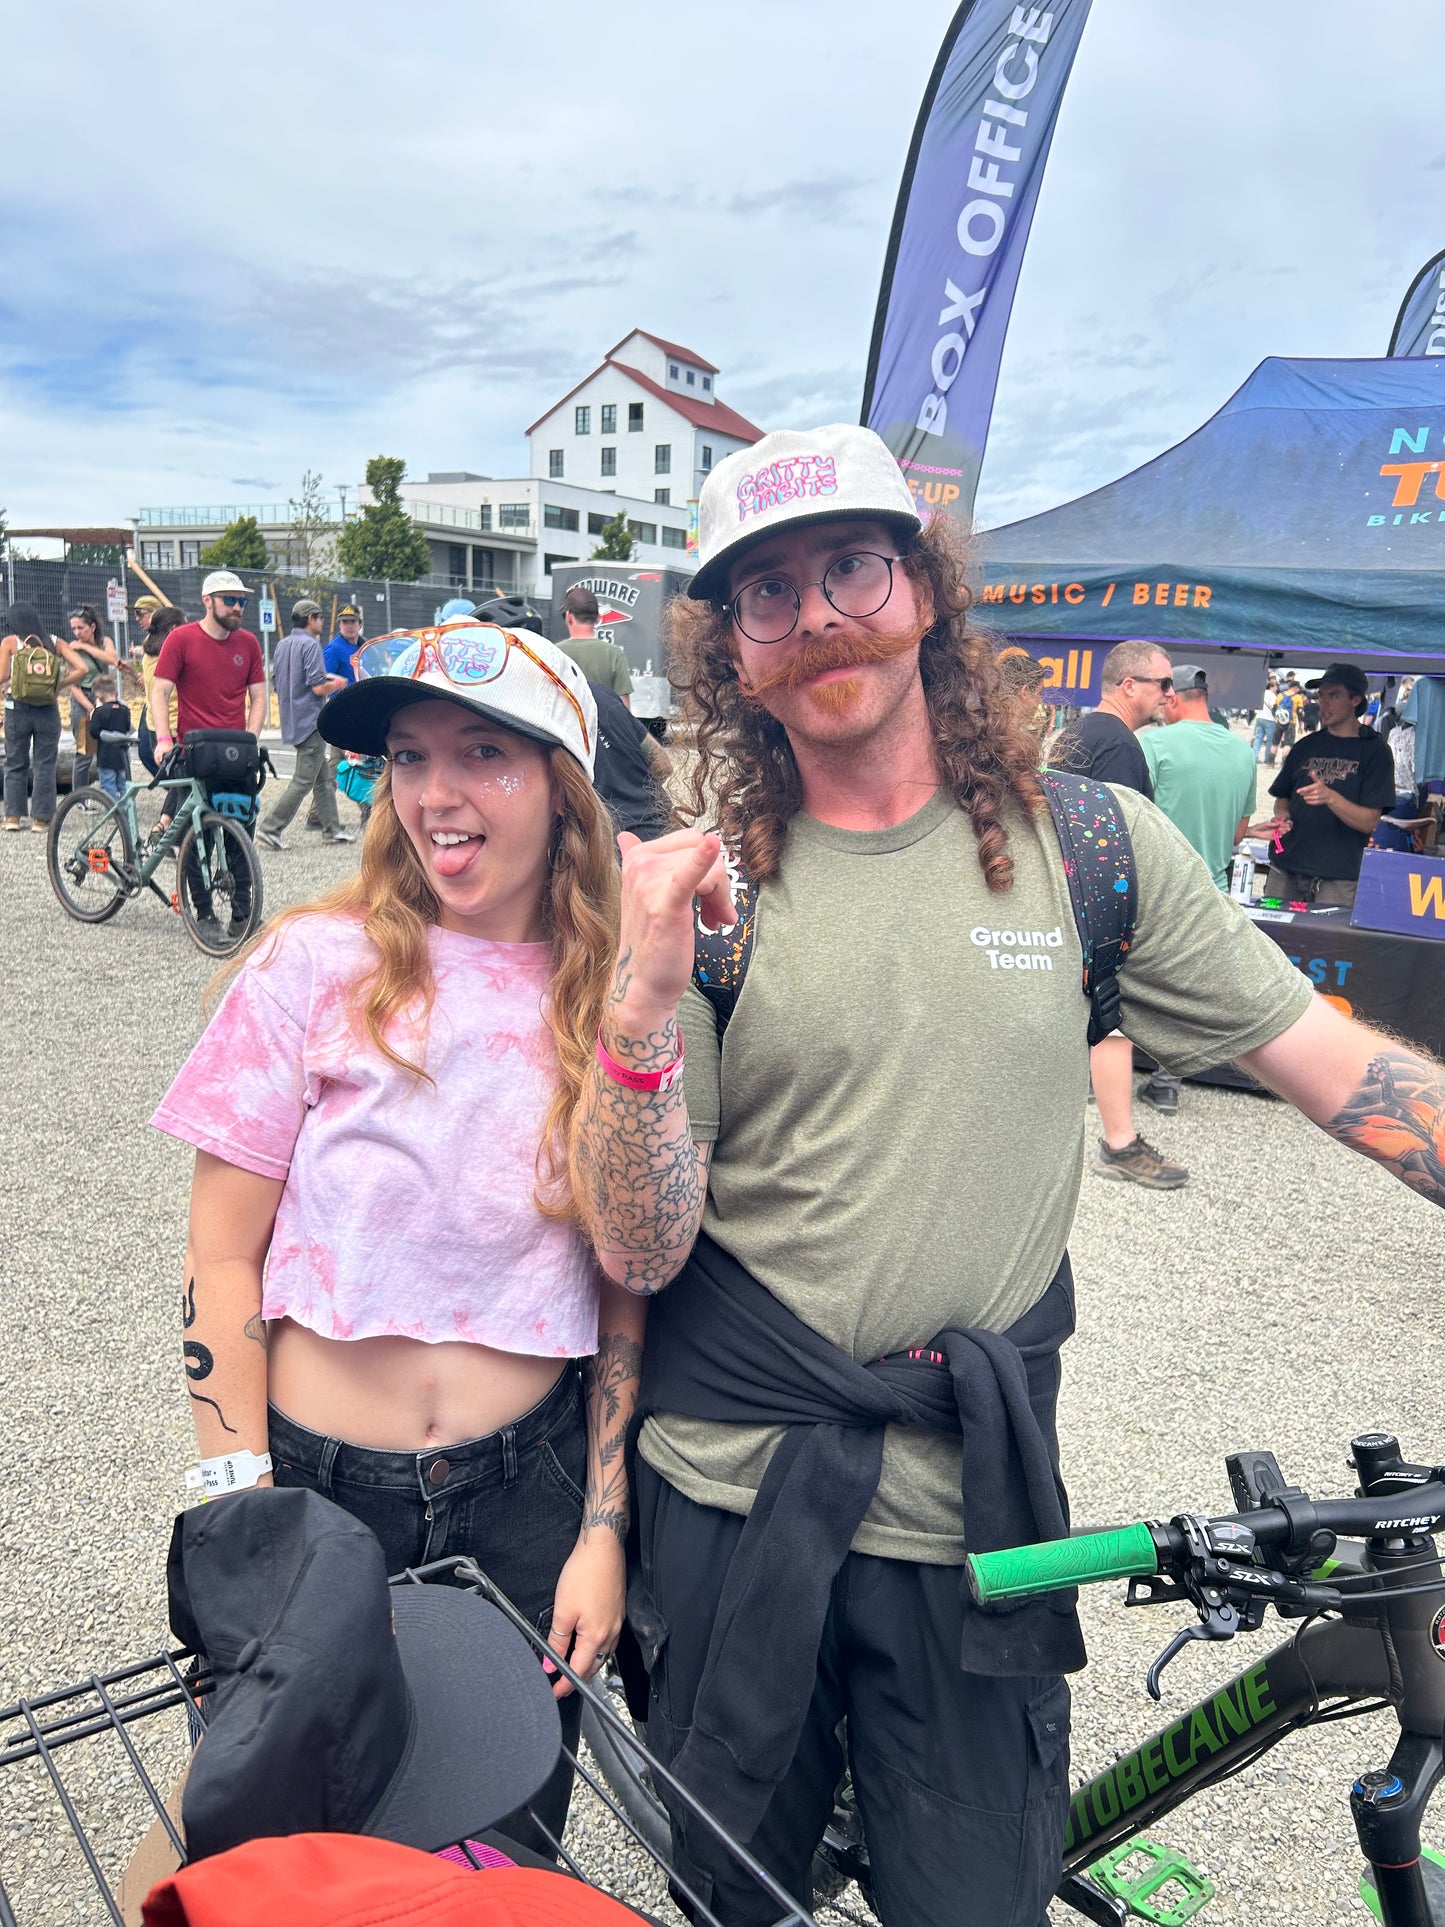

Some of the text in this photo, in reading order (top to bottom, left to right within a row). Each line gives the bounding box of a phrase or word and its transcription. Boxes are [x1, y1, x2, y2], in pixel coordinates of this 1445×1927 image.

[916, 5, 1054, 437] BOX OFFICE
[737, 456, 836, 501] GRITTY
[738, 477, 838, 521] HABITS
[1367, 511, 1445, 527] BIK
[982, 583, 1214, 608] MUSIC / BEER
[969, 926, 1063, 947] Ground
[985, 949, 1053, 970] Team
[1374, 1515, 1441, 1530] RITCHEY
[1213, 1542, 1253, 1555] SLX
[1228, 1570, 1272, 1587] SLX
